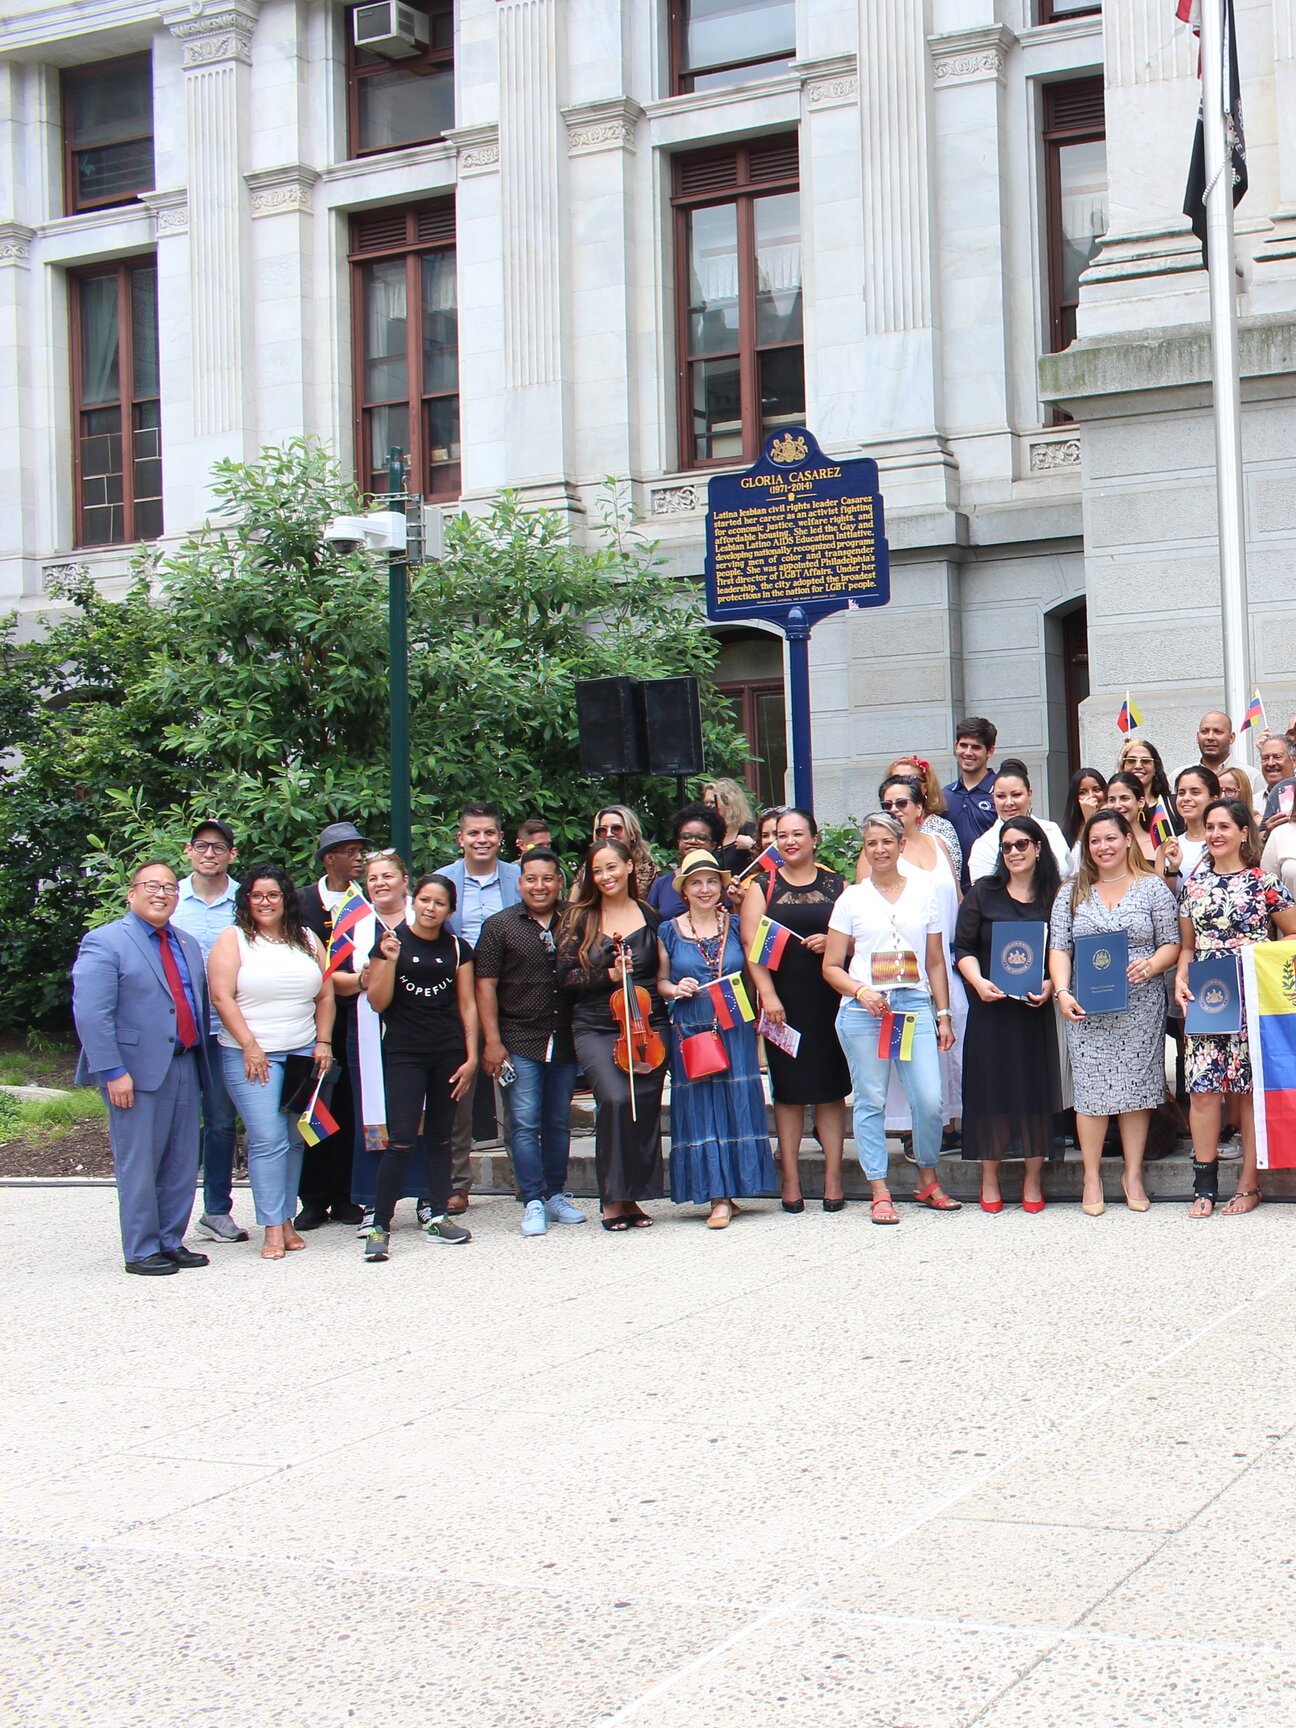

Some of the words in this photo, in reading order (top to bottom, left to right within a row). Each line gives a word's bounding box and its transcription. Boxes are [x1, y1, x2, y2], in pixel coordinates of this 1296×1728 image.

[741, 474, 783, 488] GLORIA
[789, 467, 841, 482] CASAREZ
[770, 482, 812, 494] (1971-2014)
[714, 511, 738, 519] Latina
[739, 507, 767, 516] lesbian
[768, 504, 785, 513] civil
[786, 502, 810, 513] rights
[813, 500, 838, 508] leader
[841, 496, 873, 505] Casarez
[714, 518, 742, 528] started
[760, 514, 785, 522] career
[808, 507, 839, 517] activist
[840, 504, 873, 515] fighting
[715, 533, 756, 544] affordable
[758, 530, 791, 539] housing.
[794, 528, 809, 536] She
[810, 526, 823, 534] led
[825, 524, 838, 532] the
[840, 523, 857, 532] Gay
[858, 520, 874, 529] and
[728, 524, 764, 534] economic
[798, 518, 828, 527] welfare
[858, 512, 873, 520] and
[715, 543, 744, 552] Lesbian
[746, 540, 771, 549] Latino
[773, 537, 794, 546] AIDS
[796, 534, 835, 544] Education
[716, 551, 753, 561] developing
[754, 546, 792, 556] nationally
[794, 541, 836, 553] recognized
[837, 539, 874, 550] programs
[716, 560, 745, 569] serving
[782, 554, 802, 562] color
[806, 551, 821, 560] and
[825, 546, 875, 558] transgender
[716, 568, 744, 579] people.
[747, 566, 761, 574] She
[779, 560, 819, 572] appointed
[821, 554, 875, 566] Philadelphia's
[717, 577, 735, 585] first
[736, 574, 768, 583] director
[769, 572, 778, 580] of
[780, 570, 802, 579] LGBT
[803, 568, 833, 577] Affairs.
[836, 565, 860, 573] Under
[861, 563, 875, 571] her
[775, 580, 791, 589] city
[792, 576, 824, 587] adopted
[826, 575, 840, 583] the
[840, 571, 876, 581] broadest
[717, 592, 762, 604] protections
[786, 587, 810, 595] nation
[825, 582, 847, 591] LGBT
[848, 580, 877, 591] people.
[399, 975, 453, 997] HOPEFUL
